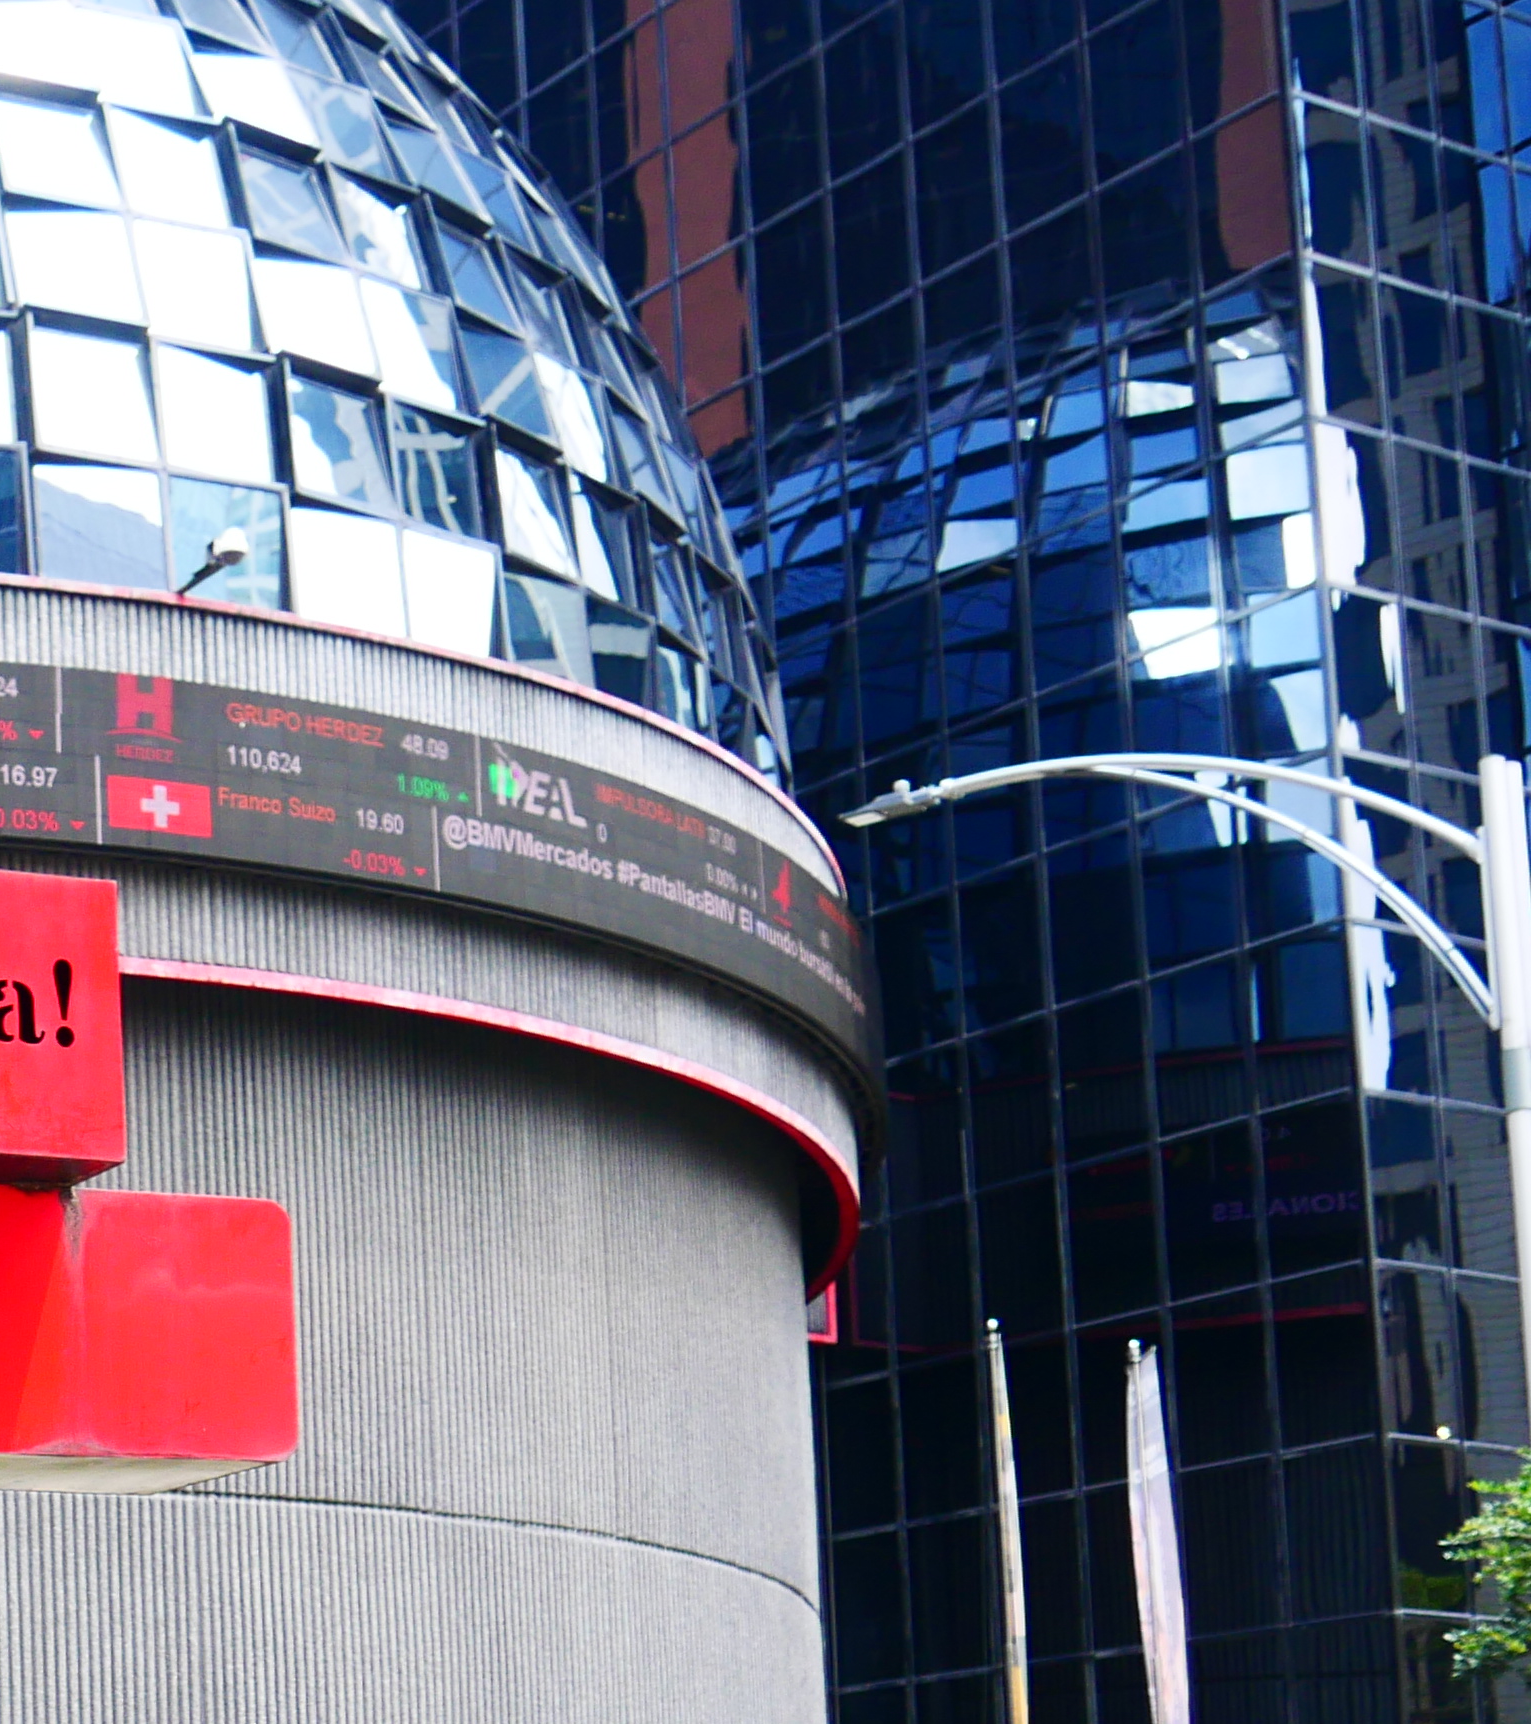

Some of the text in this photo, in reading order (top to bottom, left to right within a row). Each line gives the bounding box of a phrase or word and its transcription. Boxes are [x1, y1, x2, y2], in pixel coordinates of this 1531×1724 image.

[226, 702, 302, 732] GRUPO
[306, 715, 385, 747] HERDEZ
[0, 764, 58, 788] 16.97
[228, 744, 302, 775] 110,624
[218, 787, 405, 835] Franco Suizo 19.60
[442, 814, 614, 881] @BMVMercados
[617, 859, 738, 926] #PantallasBMV
